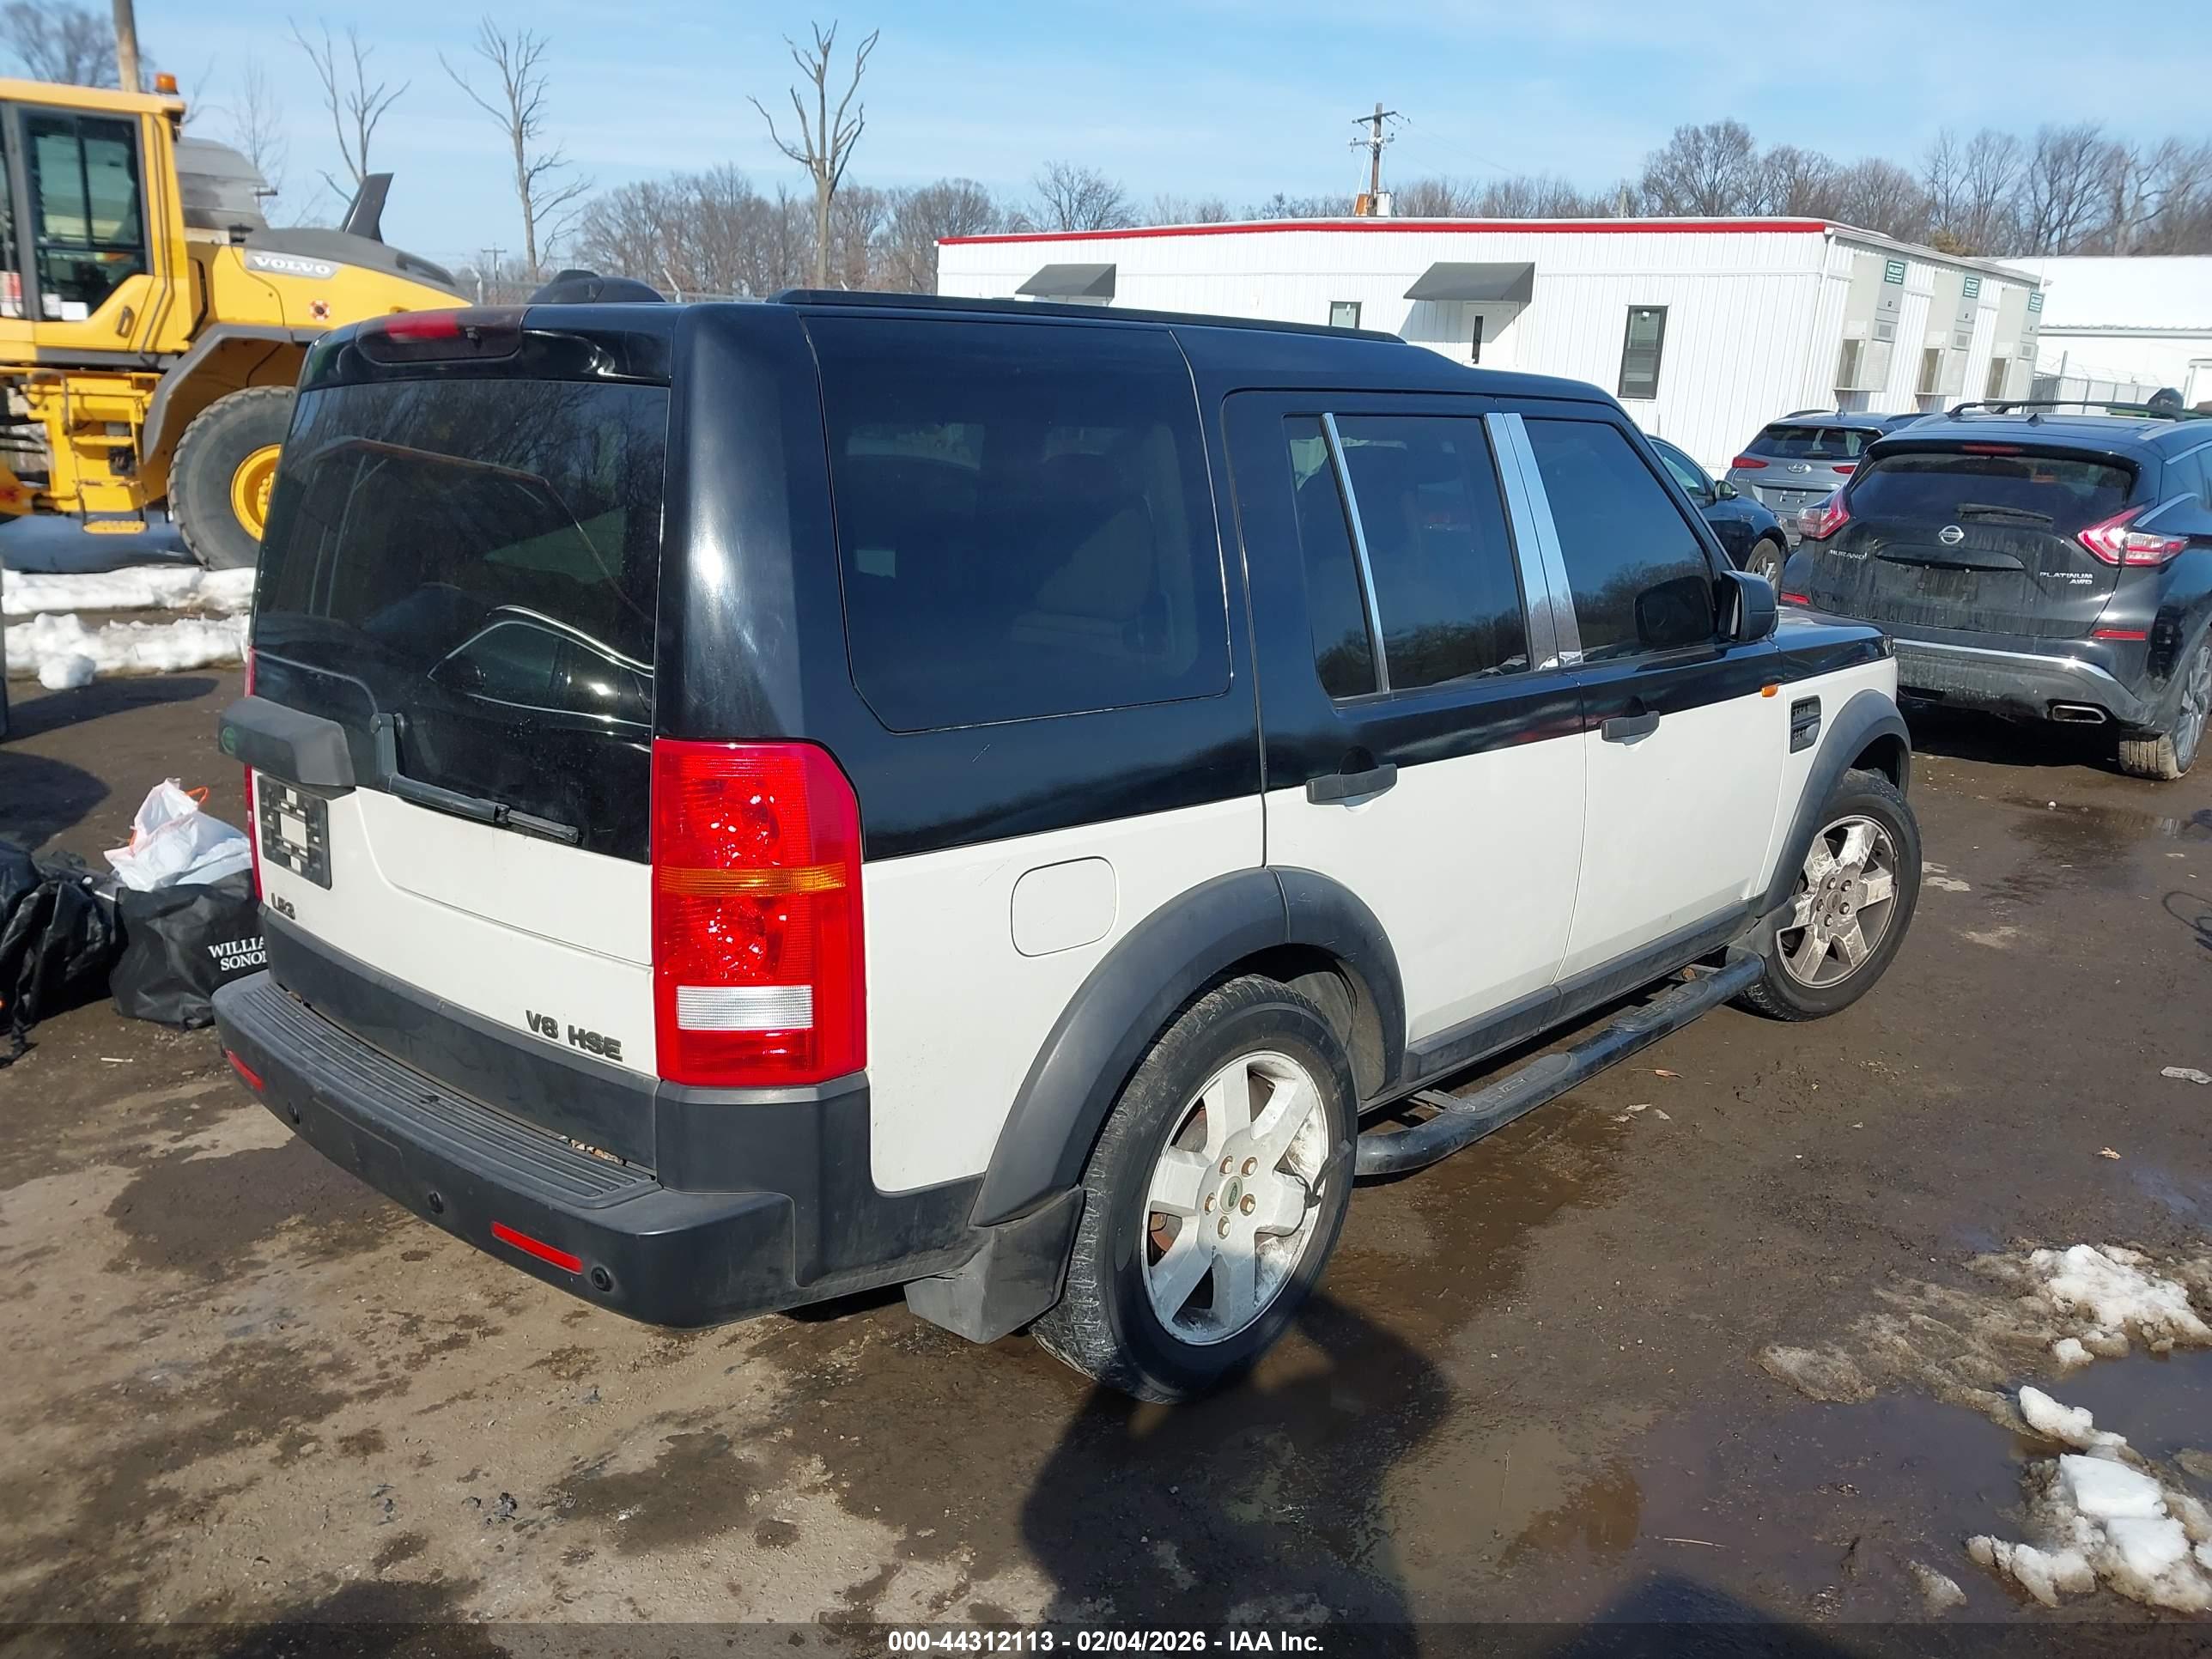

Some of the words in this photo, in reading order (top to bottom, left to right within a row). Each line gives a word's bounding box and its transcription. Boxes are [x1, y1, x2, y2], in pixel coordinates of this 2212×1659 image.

[252, 256, 331, 275] VOLVO
[1829, 549, 1865, 560] MURANO
[525, 1009, 559, 1039] V8
[568, 1024, 623, 1062] HSE
